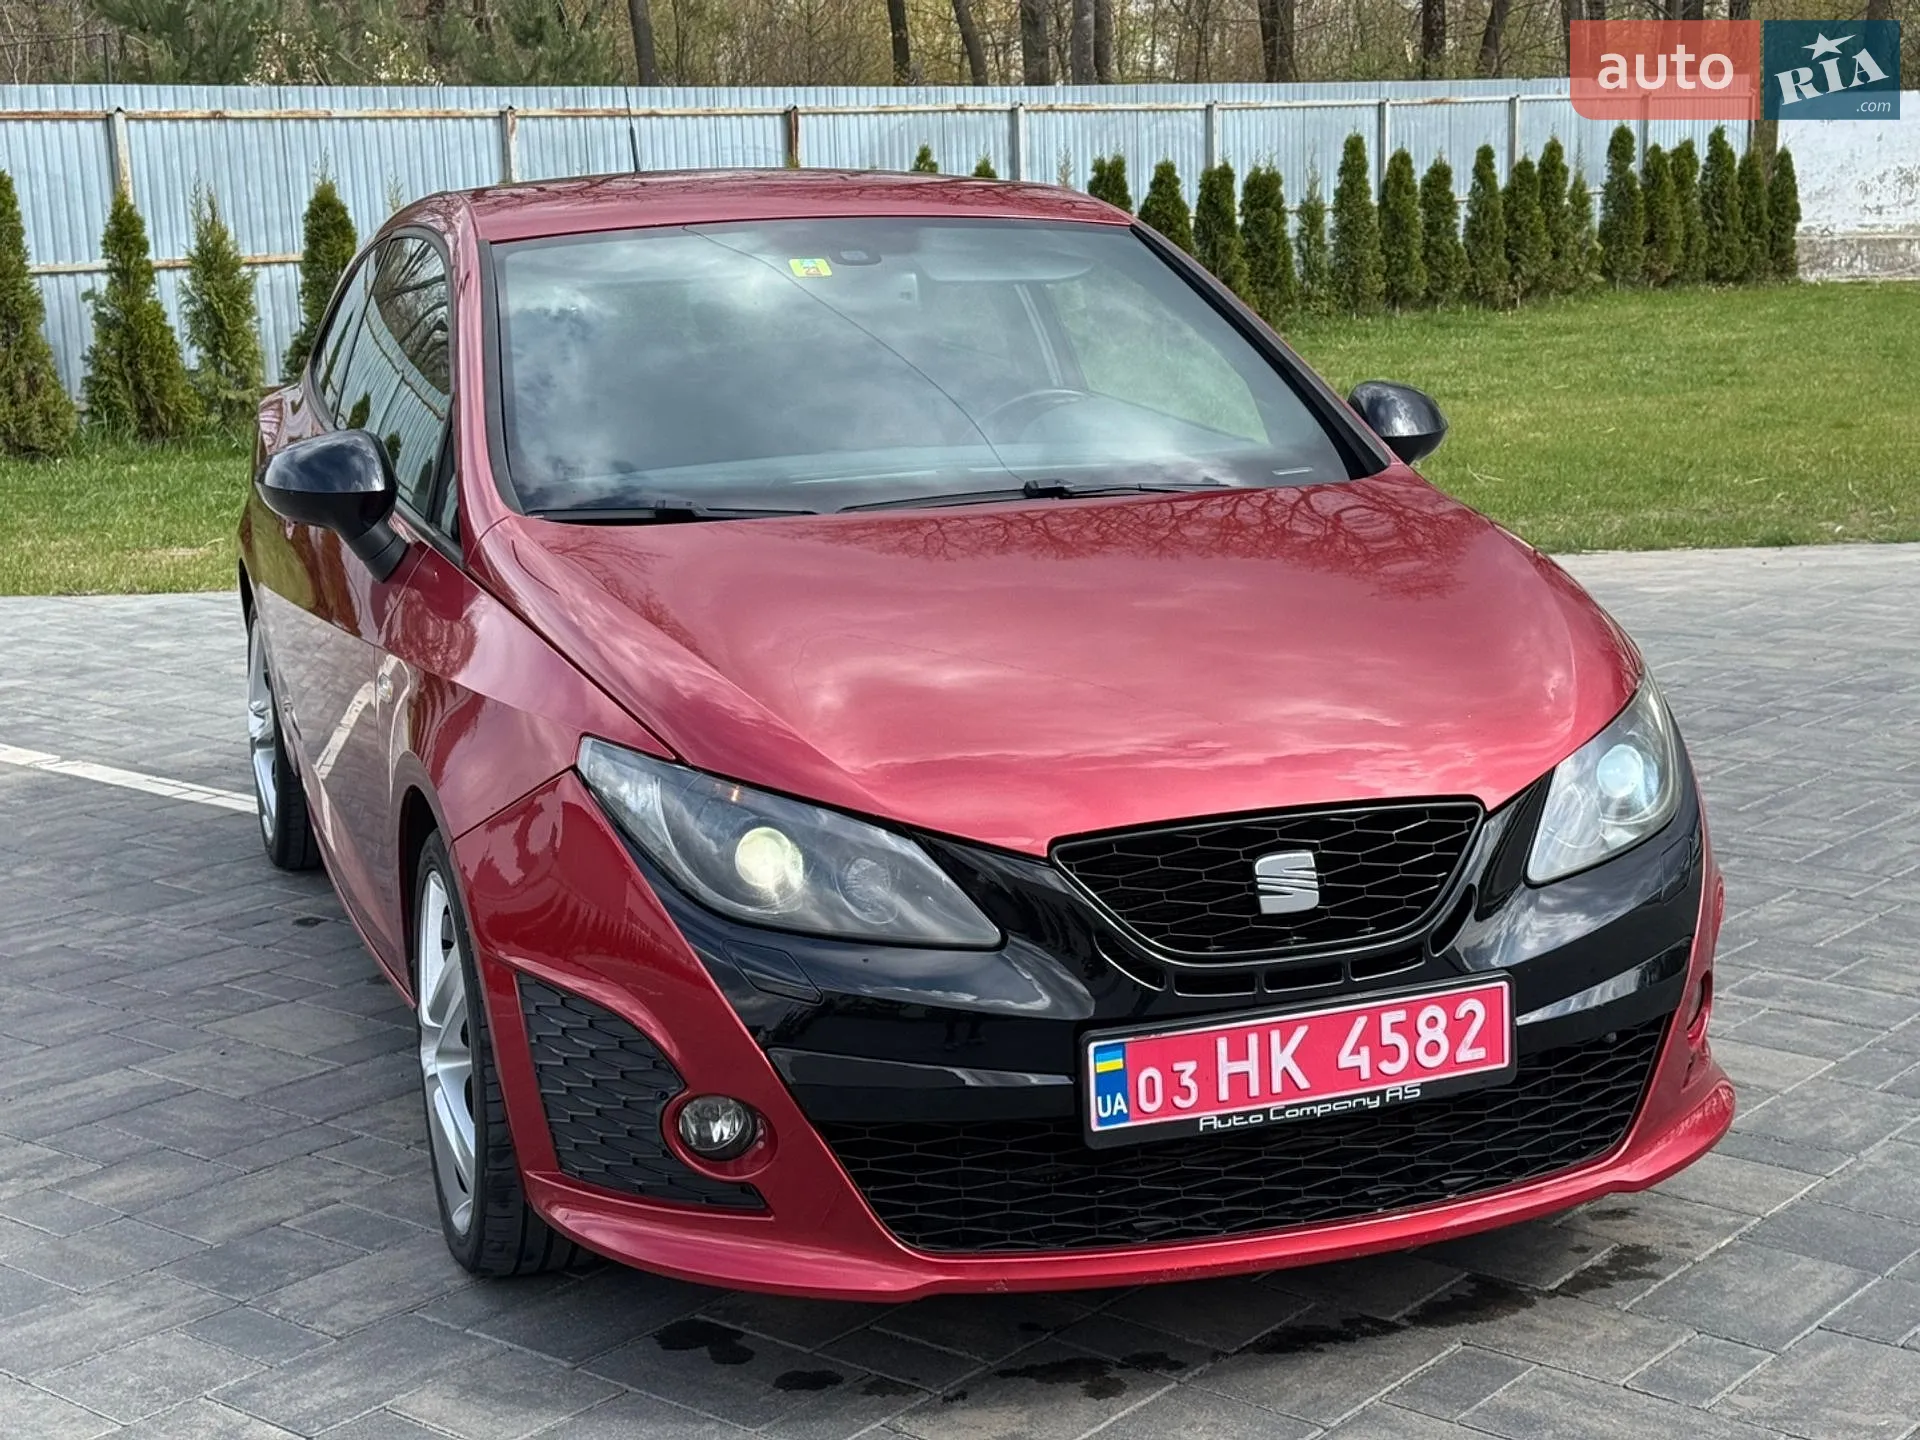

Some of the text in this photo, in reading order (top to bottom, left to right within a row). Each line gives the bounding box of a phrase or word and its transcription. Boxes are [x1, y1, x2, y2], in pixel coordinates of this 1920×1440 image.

[1137, 998, 1487, 1113] 03 HK 4582
[1097, 1091, 1128, 1118] UA
[1199, 1084, 1421, 1132] Auto Company AS
